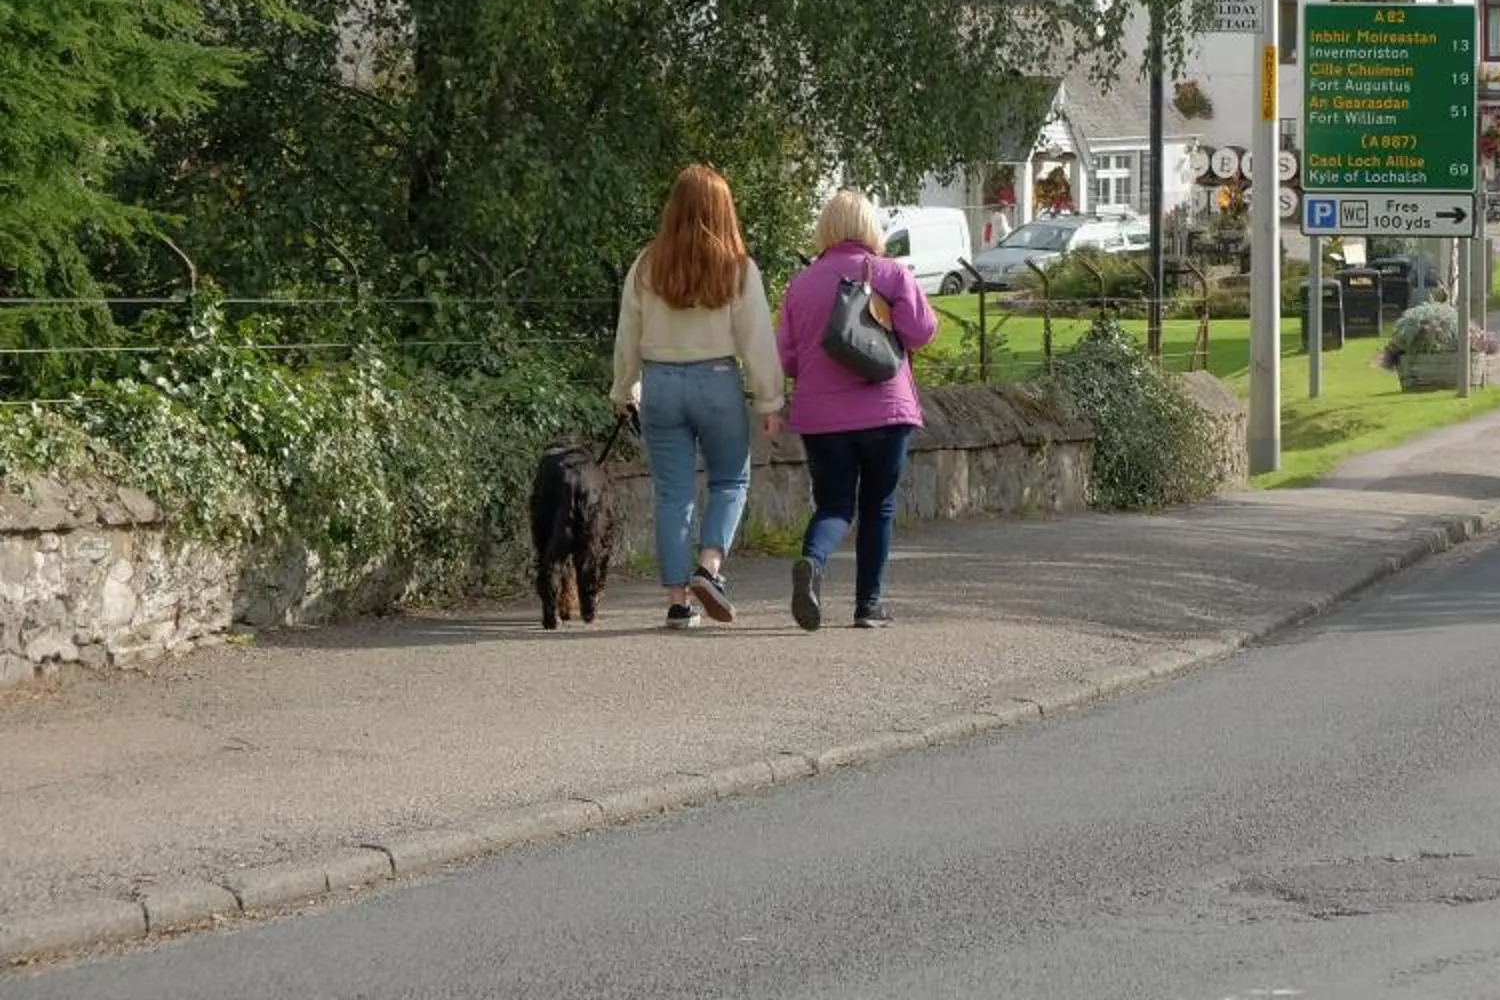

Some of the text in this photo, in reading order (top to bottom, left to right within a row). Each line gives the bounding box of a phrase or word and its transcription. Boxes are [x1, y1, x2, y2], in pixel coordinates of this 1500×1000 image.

[1310, 46, 1408, 59] Invermoriston
[1453, 39, 1469, 53] 13
[1452, 72, 1469, 85] 19
[1310, 78, 1411, 94] Fort Augustus
[1309, 111, 1397, 125] Fort William
[1450, 105, 1467, 118] 51
[1347, 154, 1380, 167] Loch
[1309, 169, 1427, 184] Kyle of Lochalsh
[1450, 163, 1469, 177] 69
[1386, 199, 1419, 213] Free
[1315, 203, 1333, 226] P
[1343, 207, 1365, 223] WC
[1373, 215, 1431, 230] 100 yds
